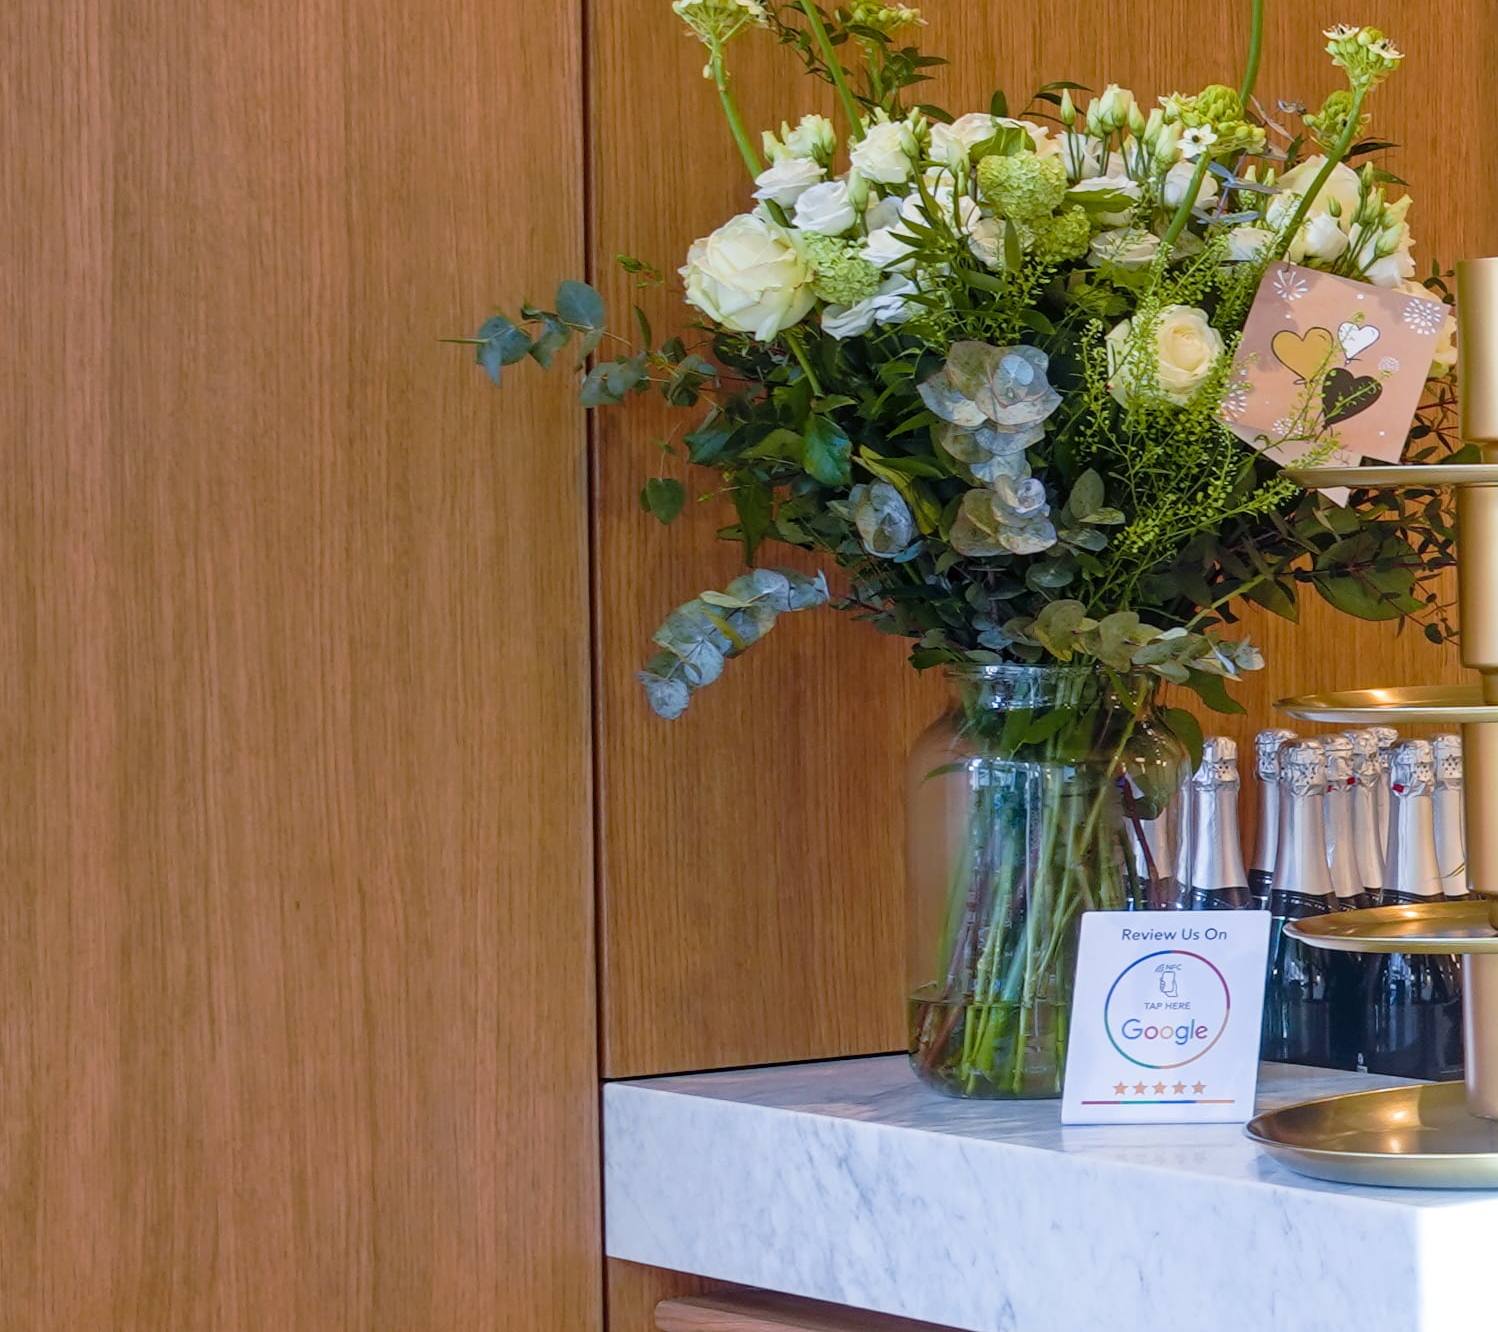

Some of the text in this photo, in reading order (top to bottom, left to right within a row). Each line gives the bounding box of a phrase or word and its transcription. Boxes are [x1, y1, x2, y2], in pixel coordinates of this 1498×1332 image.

[1121, 928, 1228, 942] Review Us On
[1144, 1001, 1191, 1010] TAP HERE
[1121, 1018, 1208, 1045] Google
